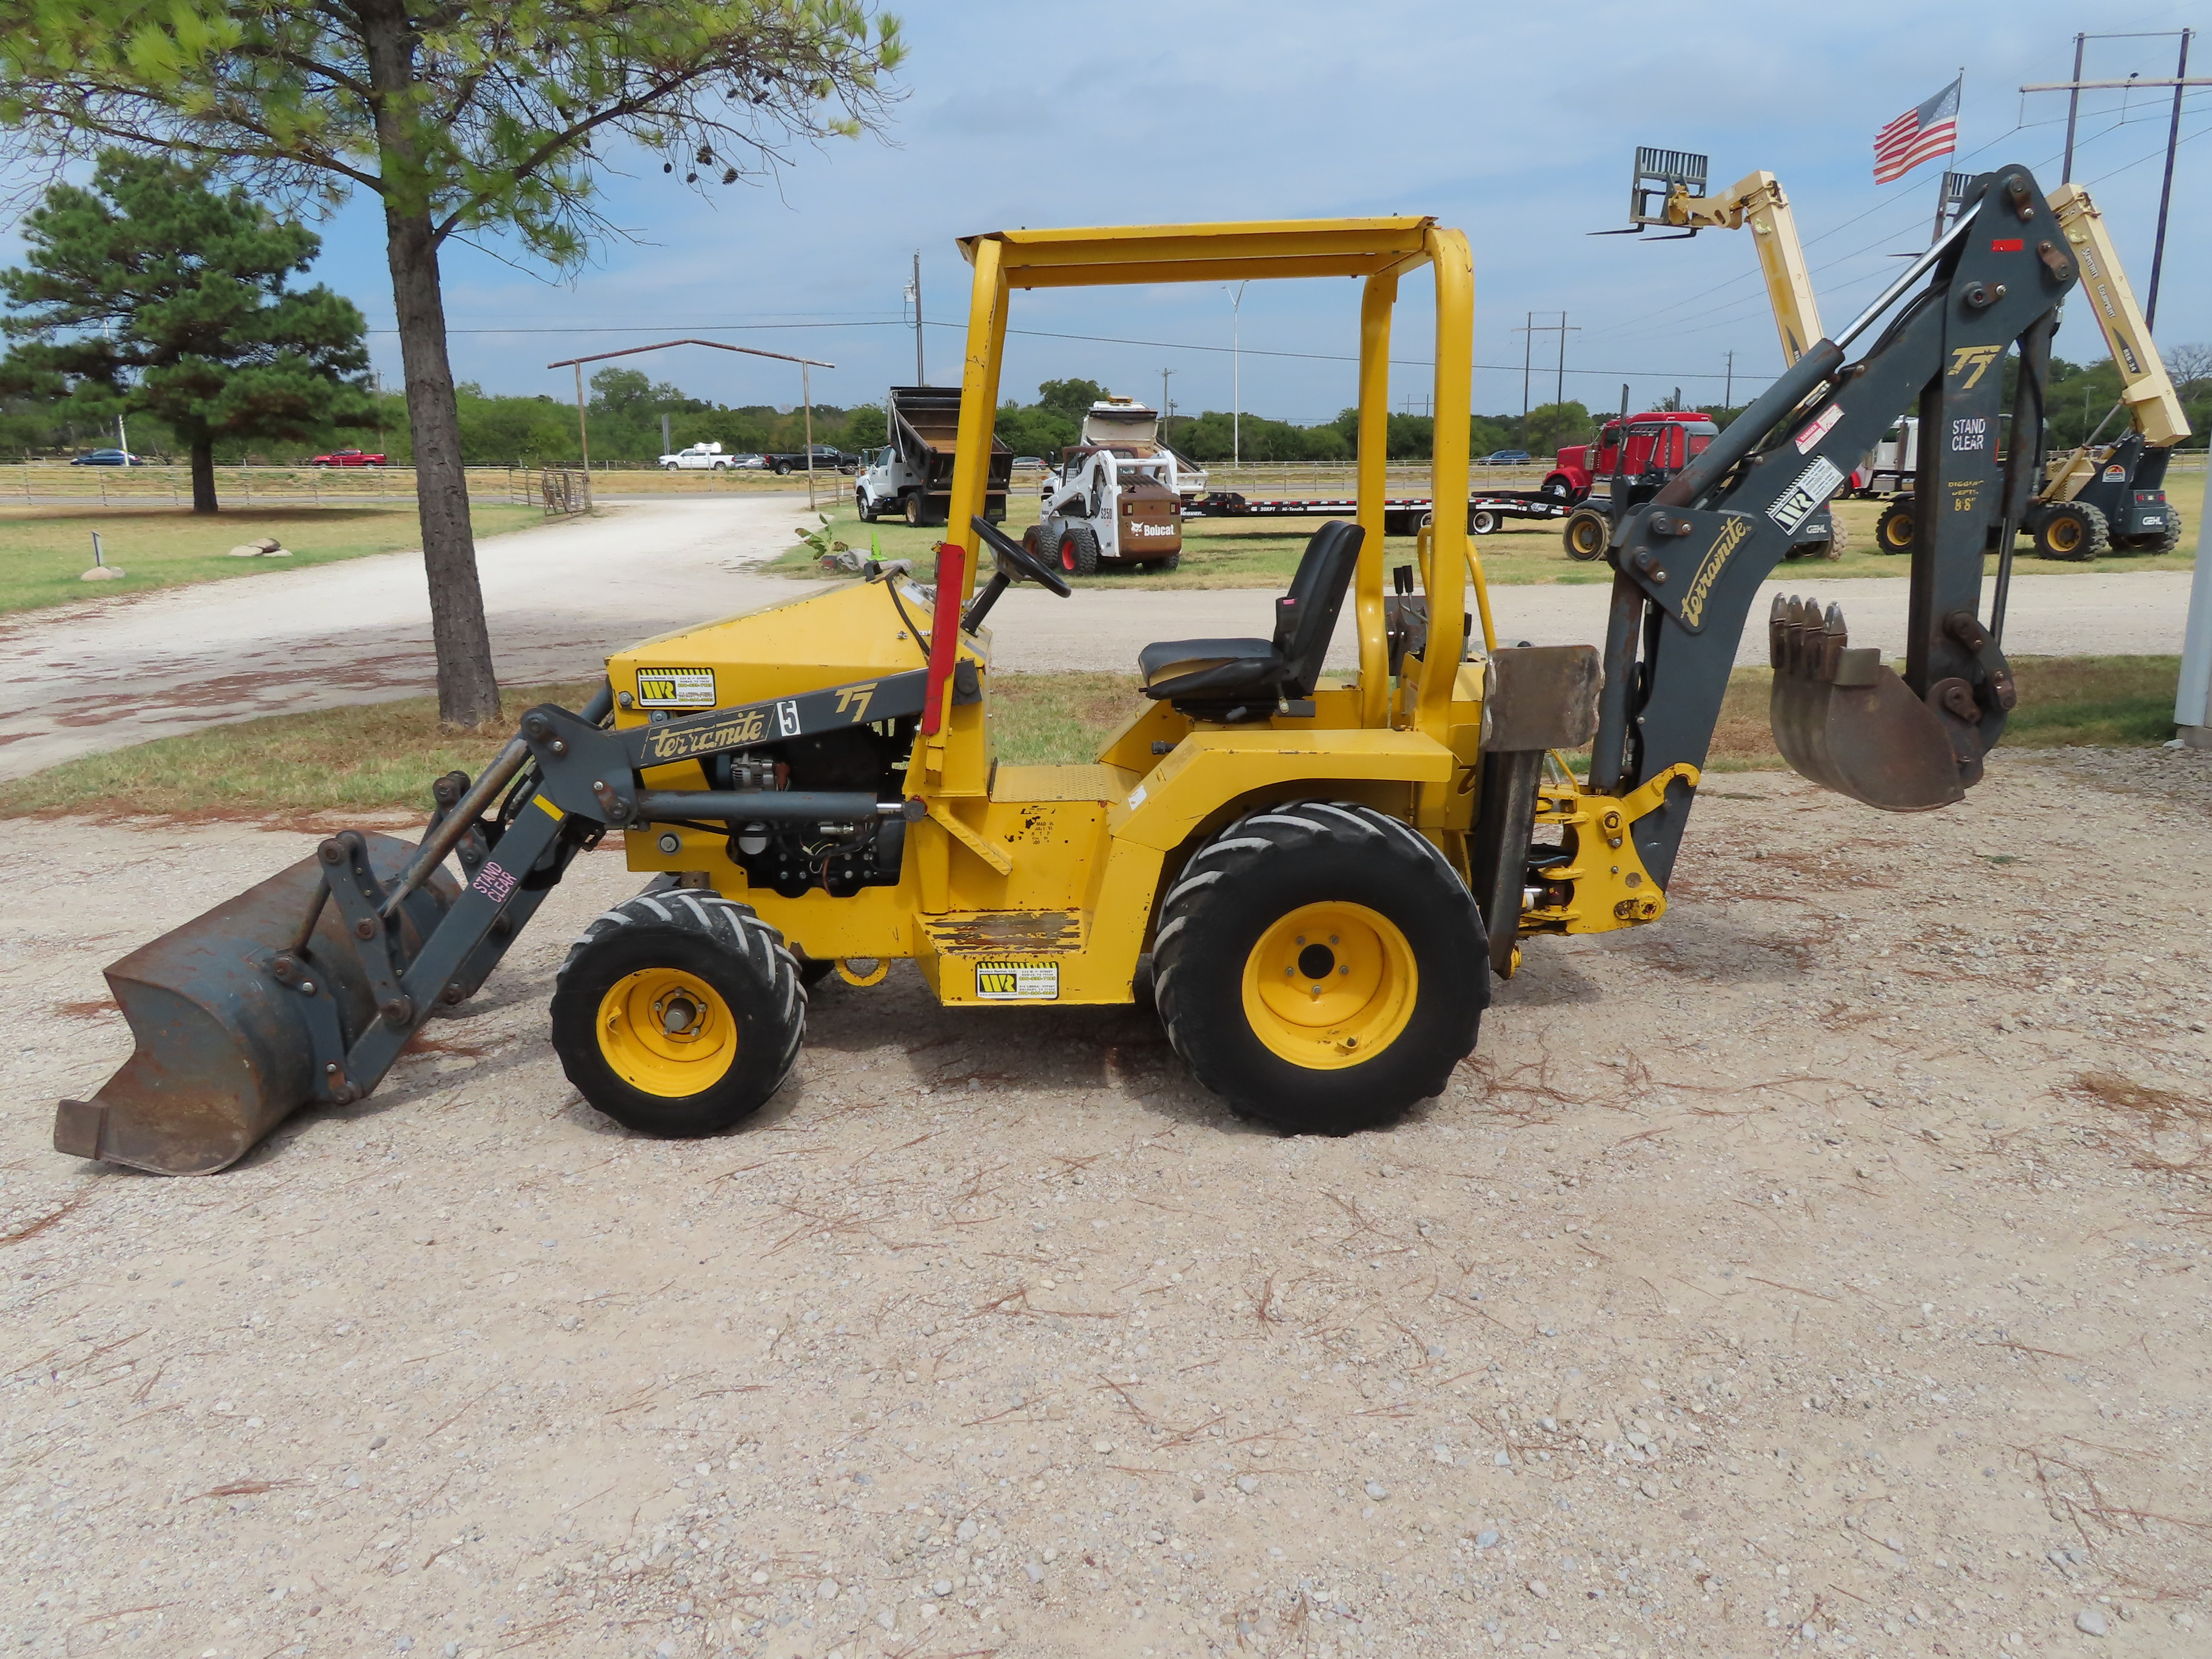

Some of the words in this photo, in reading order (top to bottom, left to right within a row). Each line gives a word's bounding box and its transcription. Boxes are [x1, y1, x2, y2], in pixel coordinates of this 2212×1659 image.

[1800, 424, 1818, 441] DANGER
[1952, 418, 1986, 434] STAND
[1951, 435, 1983, 451] CLEAR
[1101, 508, 1112, 519] S250
[2142, 517, 2163, 526] GEHL
[1144, 523, 1175, 537] Bobcat
[1806, 524, 1827, 534] GEHL
[1681, 515, 1746, 627] terramite
[834, 682, 878, 722] T7
[783, 705, 797, 735] 5
[649, 711, 765, 758] terramite
[472, 861, 503, 894] STAND
[487, 871, 517, 903] CLEAR
